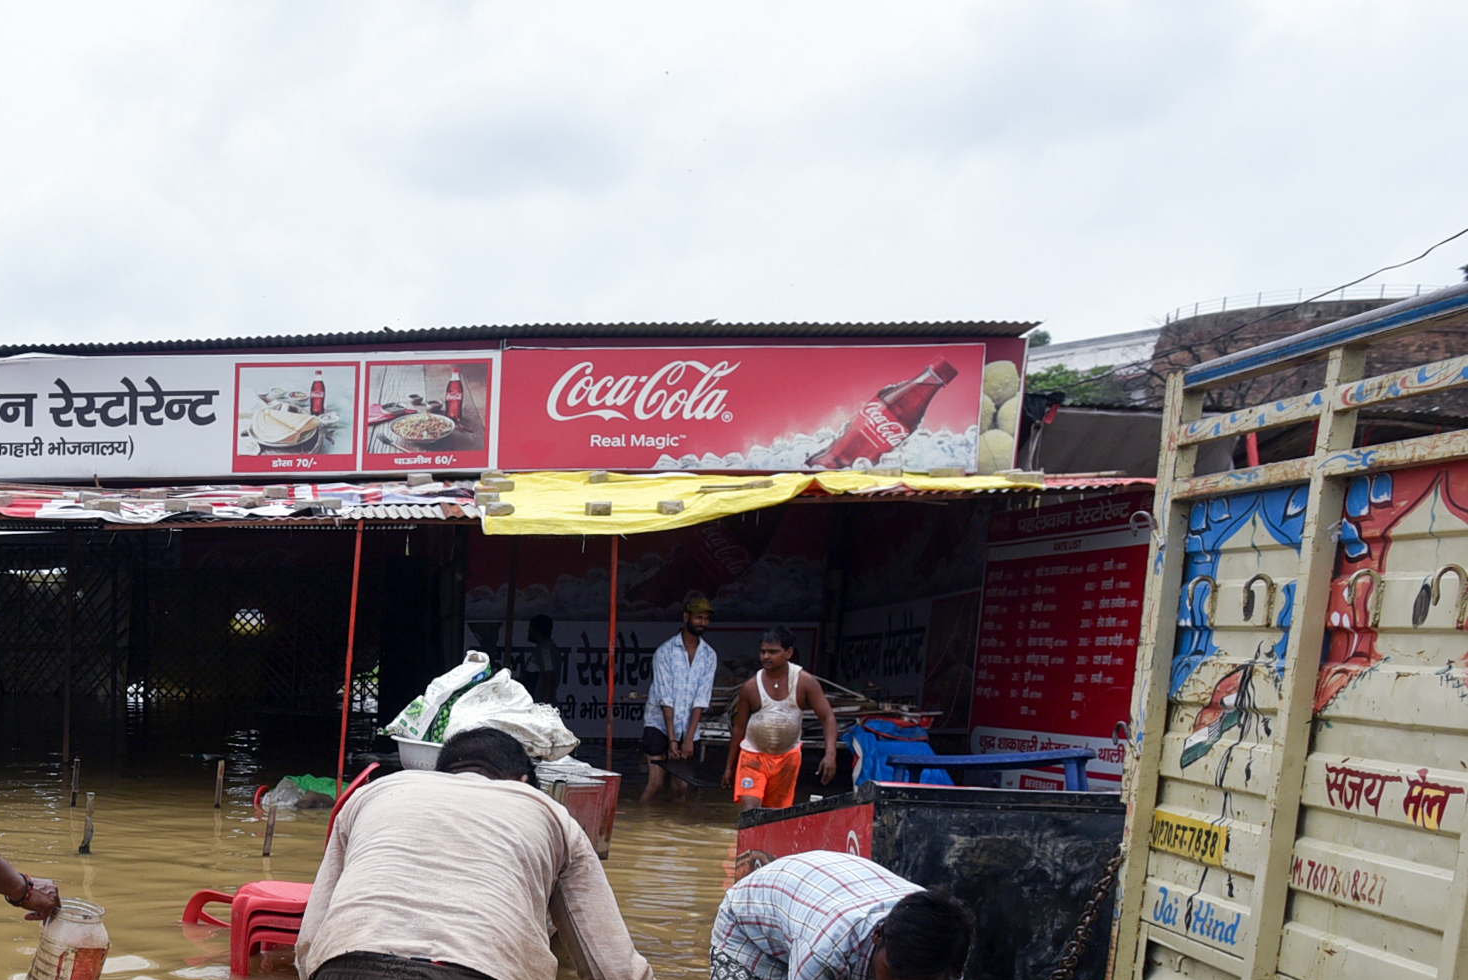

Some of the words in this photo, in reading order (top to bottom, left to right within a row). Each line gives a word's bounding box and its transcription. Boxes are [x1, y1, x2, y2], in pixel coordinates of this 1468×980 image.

[48, 376, 219, 427] रेस्टोरेन्ट
[47, 435, 134, 461] भोजनालय)
[590, 434, 627, 448] Real
[272, 457, 293, 469] डोसा
[296, 458, 318, 468] 70/-
[394, 456, 432, 467] चाऊमीन
[435, 456, 457, 466] 60/-
[1018, 511, 1072, 533] पहलवान
[1153, 886, 1179, 926] Jai
[1192, 900, 1241, 945] Hind
